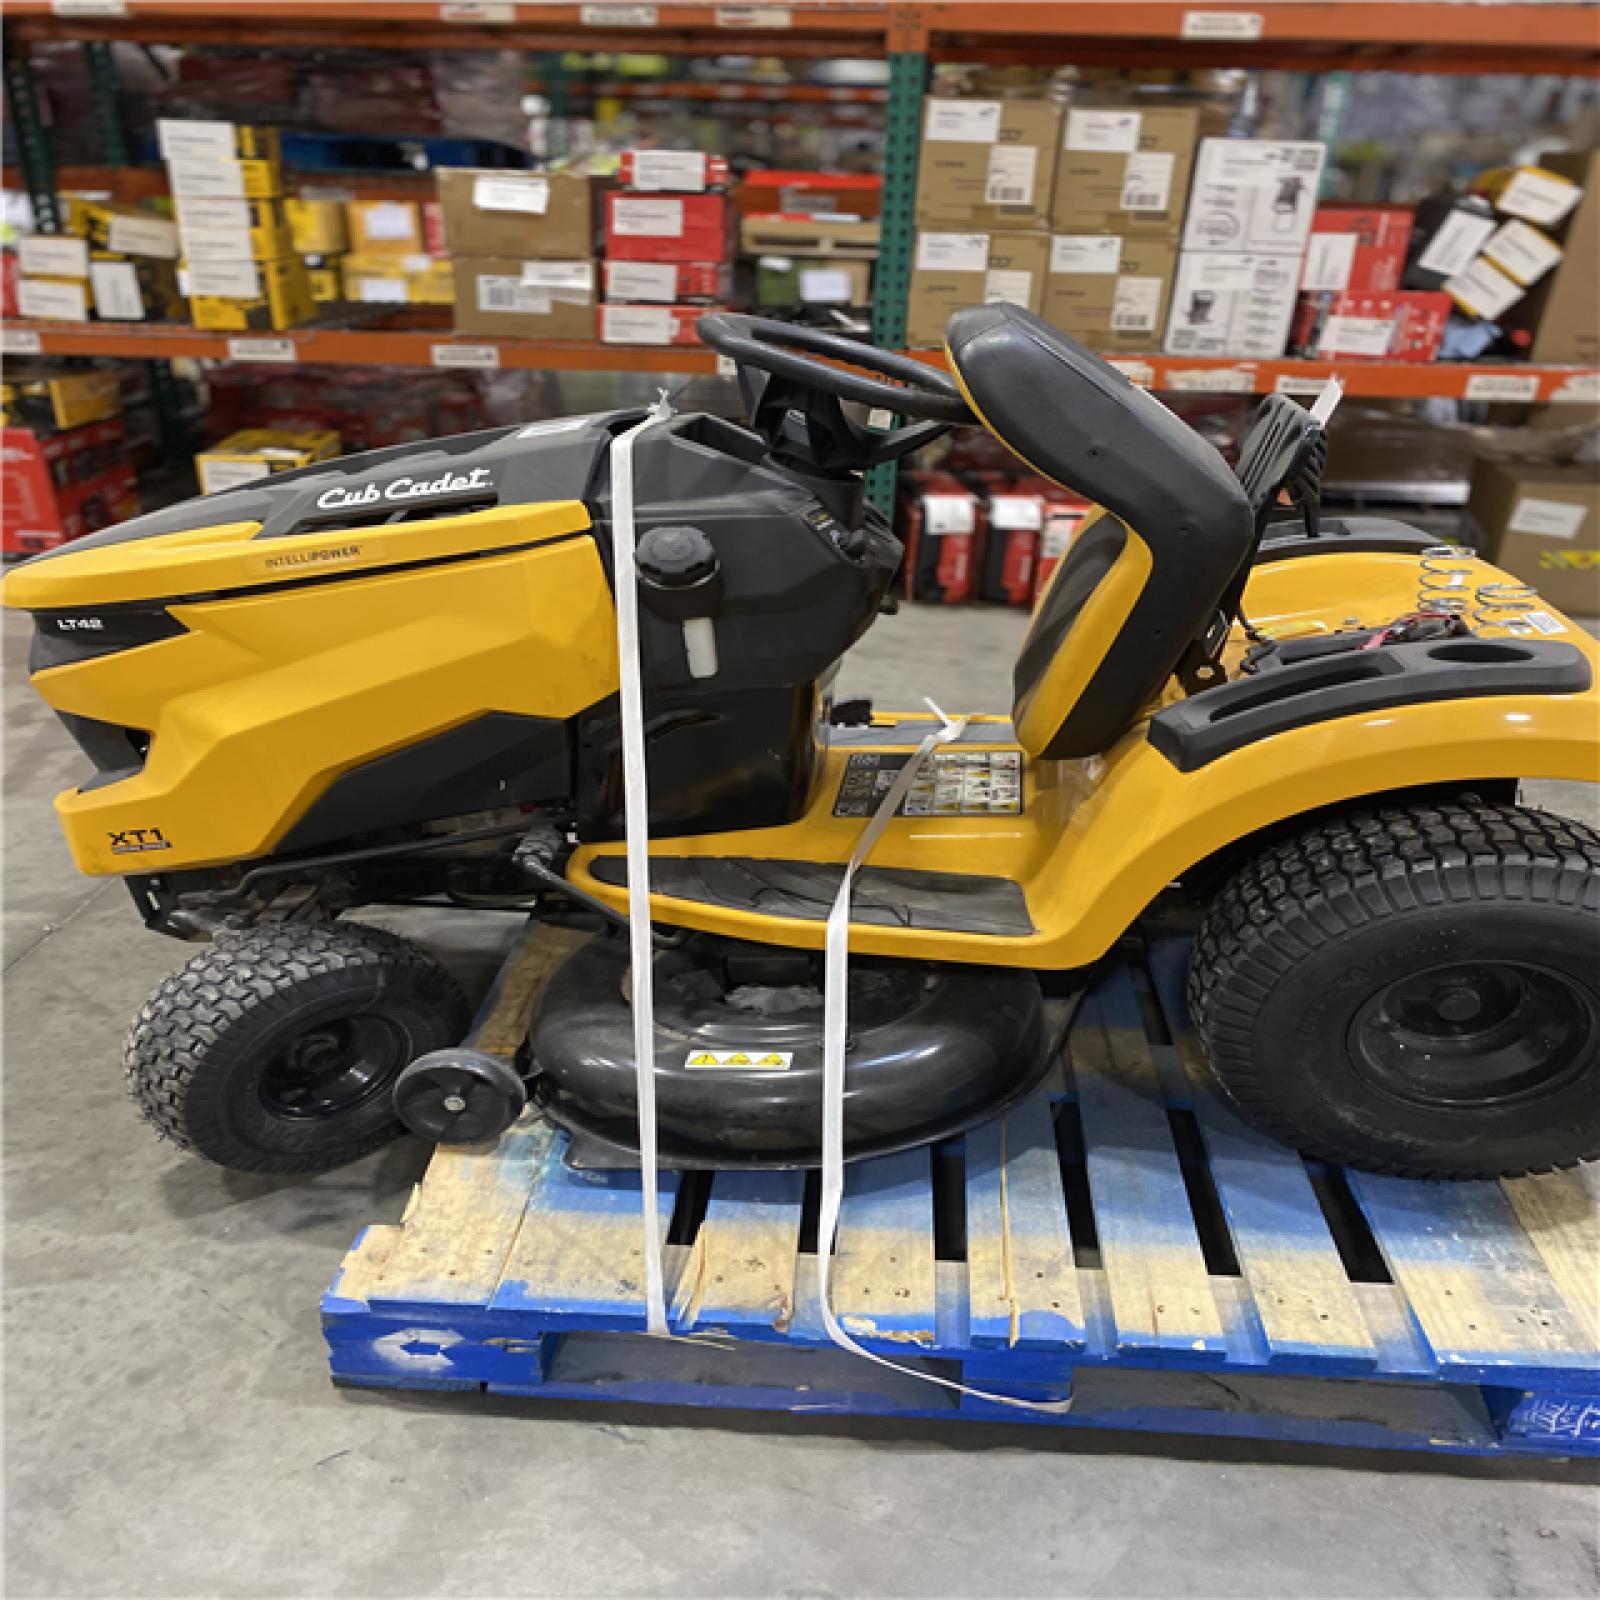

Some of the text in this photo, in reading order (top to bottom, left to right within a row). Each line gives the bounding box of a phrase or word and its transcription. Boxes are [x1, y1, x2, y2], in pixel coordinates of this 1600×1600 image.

[317, 467, 490, 509] Cub Cadet
[264, 545, 360, 569] INTELLIPOWER
[56, 617, 104, 631] LT42
[107, 827, 163, 849] XT1
